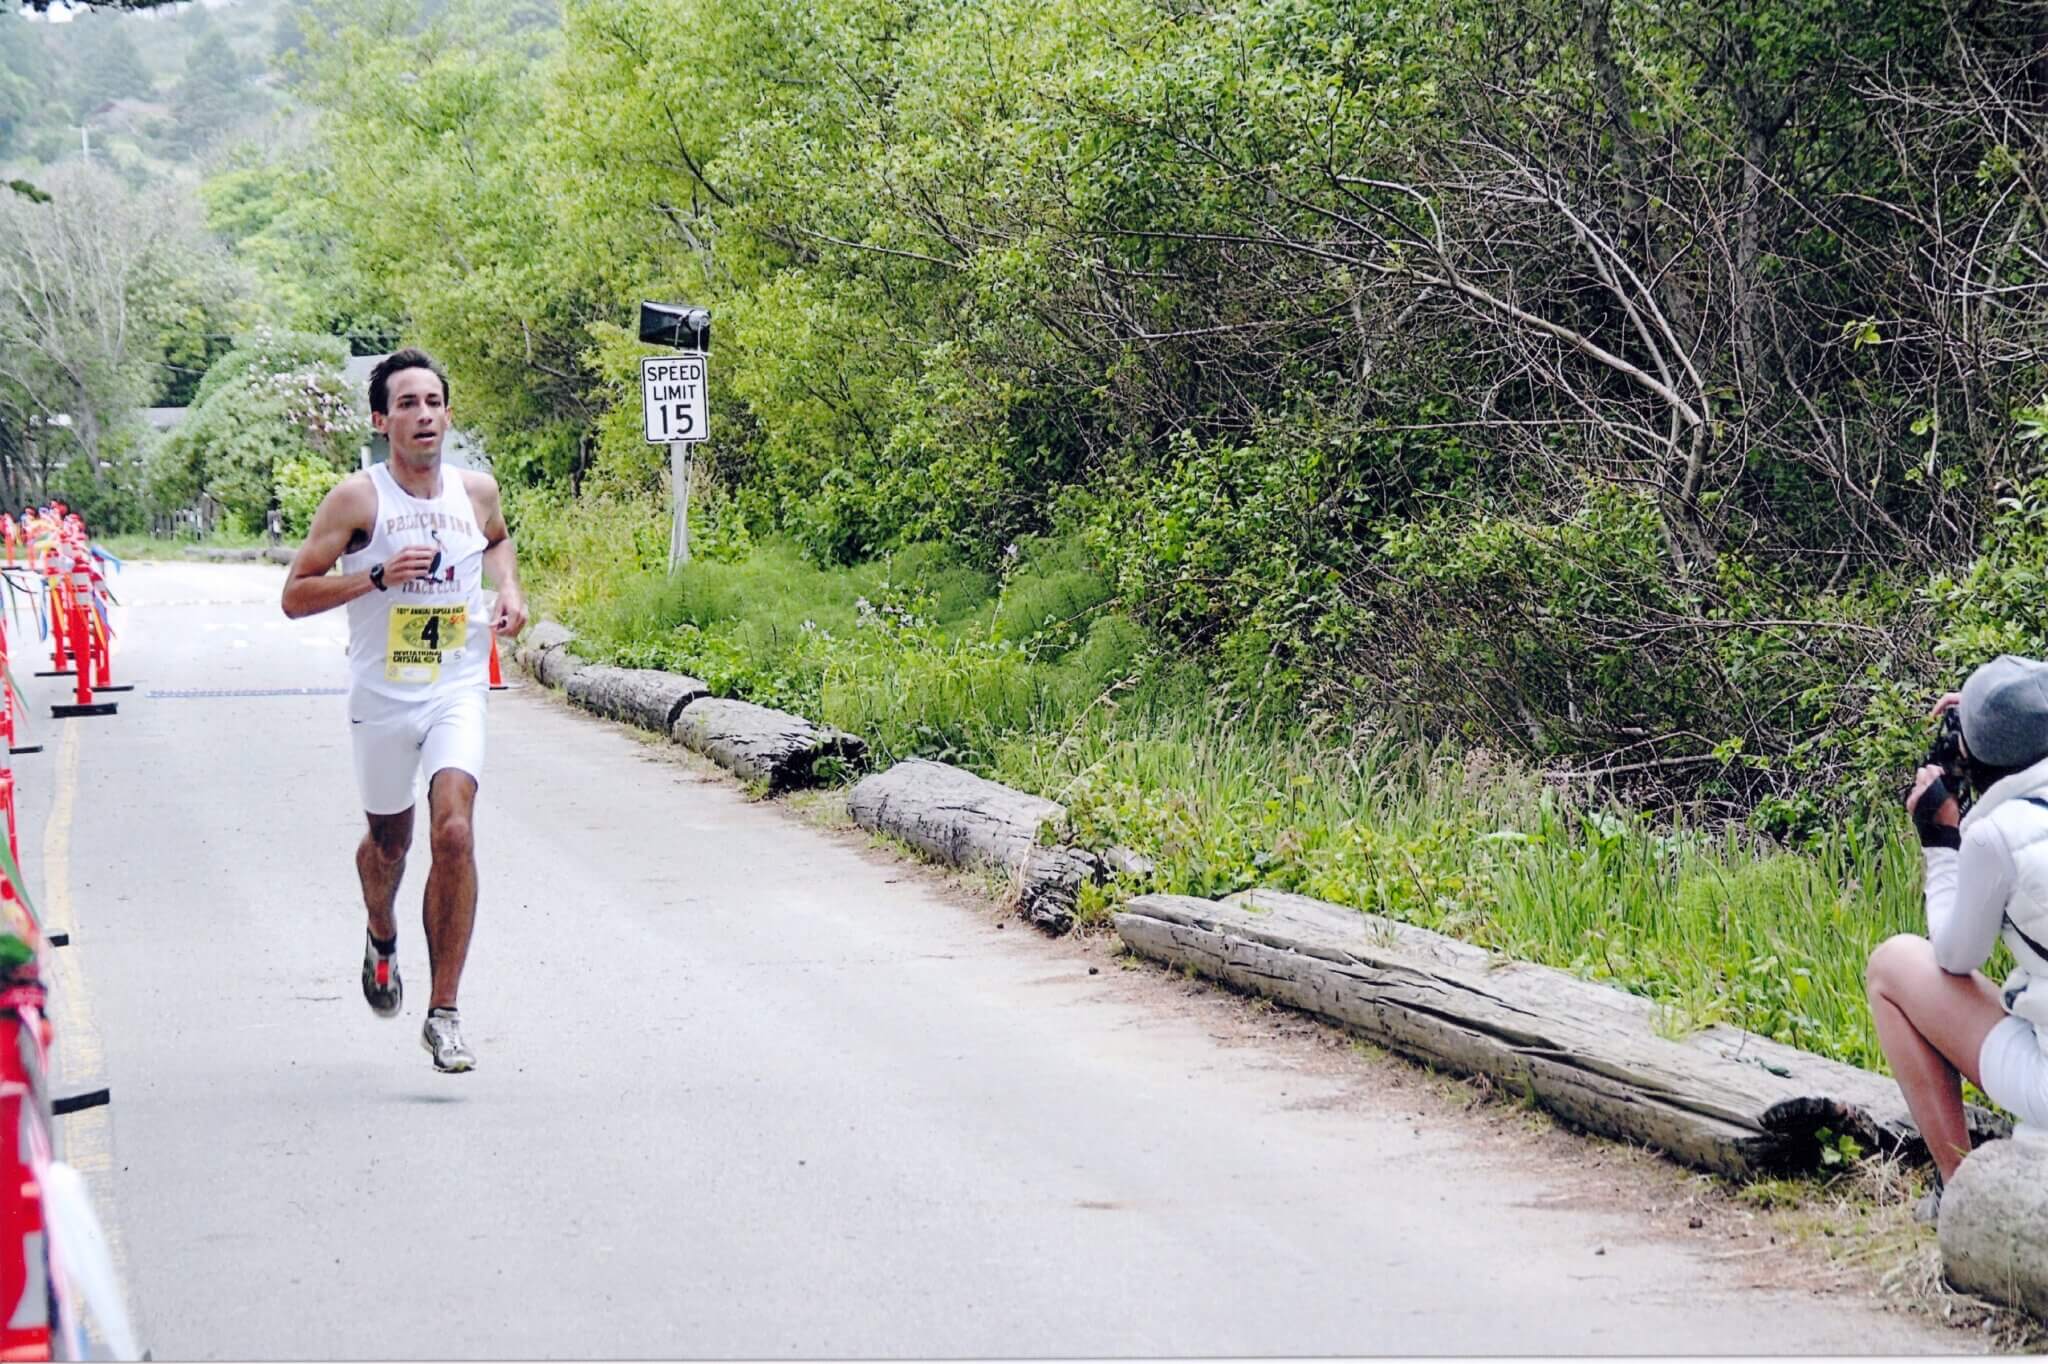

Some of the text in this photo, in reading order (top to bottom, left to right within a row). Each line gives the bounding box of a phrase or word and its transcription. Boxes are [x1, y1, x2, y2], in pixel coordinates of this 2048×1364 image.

[647, 365, 701, 382] SPEED
[653, 384, 697, 401] LIMIT
[659, 404, 694, 435] 15
[386, 512, 446, 536] PELICAN
[402, 580, 434, 595] TRACK
[421, 616, 439, 650] 4
[393, 656, 422, 664] CRYSTAL
